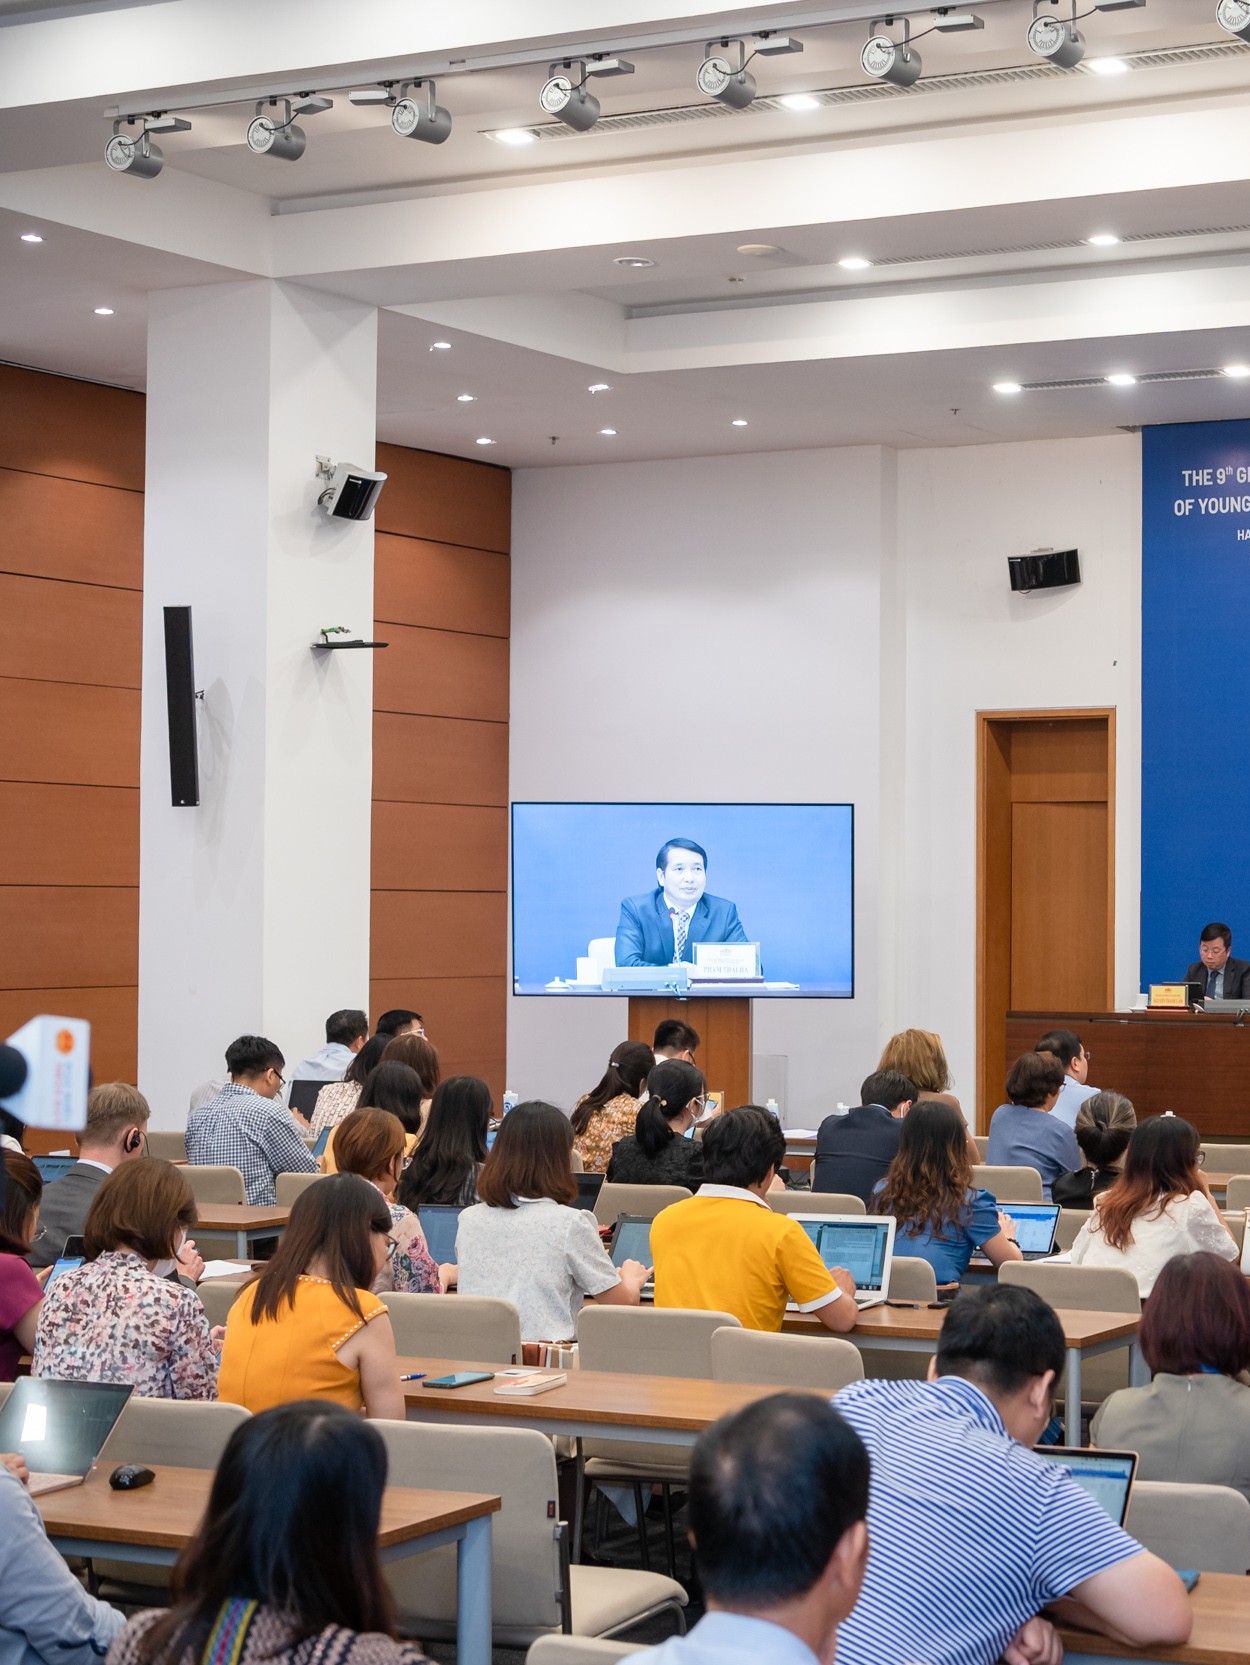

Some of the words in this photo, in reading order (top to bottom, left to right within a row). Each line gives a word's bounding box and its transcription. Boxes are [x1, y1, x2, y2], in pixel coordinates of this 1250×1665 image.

[1182, 468, 1213, 487] THE
[1216, 466, 1233, 484] 9th
[1174, 499, 1194, 516] OF
